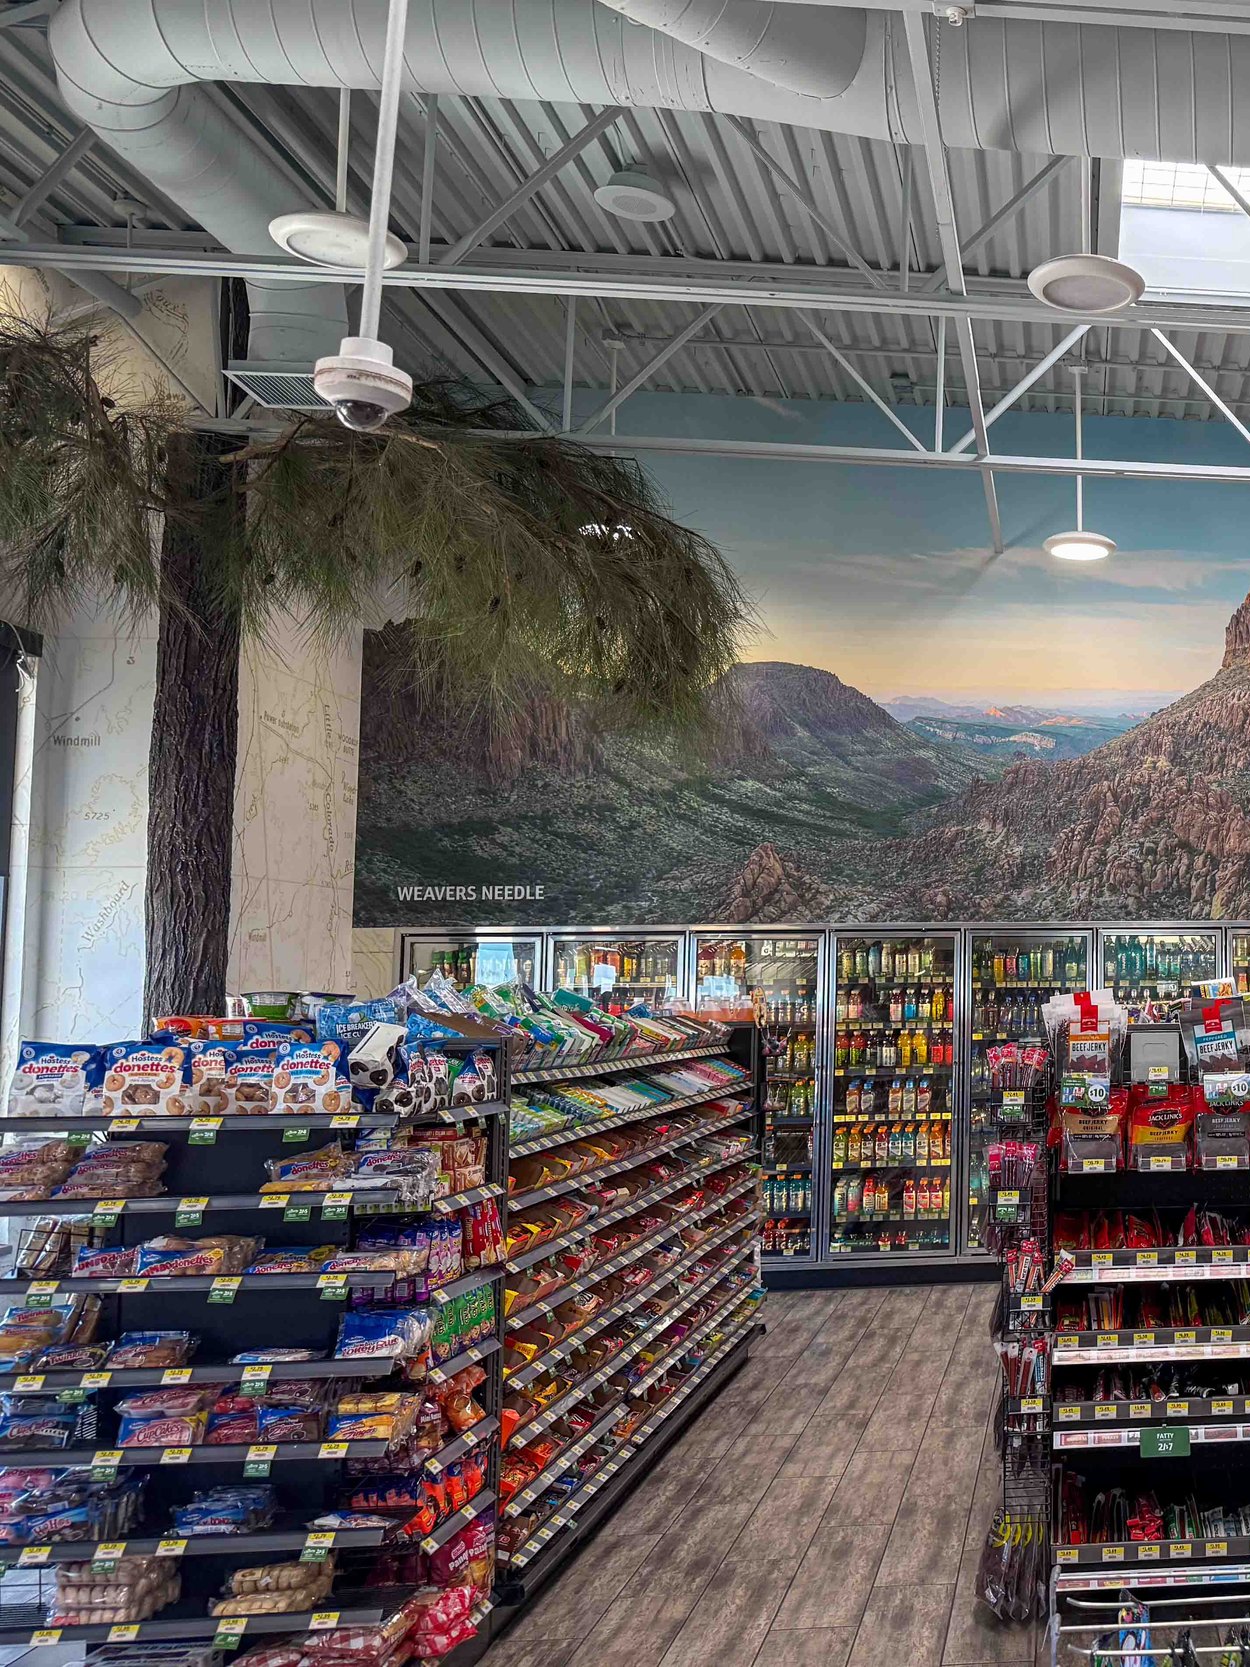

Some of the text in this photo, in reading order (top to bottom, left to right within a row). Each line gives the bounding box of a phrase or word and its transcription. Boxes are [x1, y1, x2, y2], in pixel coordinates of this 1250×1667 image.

[53, 736, 101, 747] Windmill
[84, 812, 110, 821] 5725
[325, 793, 335, 852] Colorado
[397, 885, 545, 901] WEAVERS NEEDLE
[1071, 1042, 1107, 1052] BEEF JERKY
[1200, 1041, 1233, 1054] BEEF JERKY
[40, 1057, 72, 1065] Hostess
[131, 1055, 163, 1063] Hostess
[295, 1052, 321, 1060] Hostess
[22, 1063, 79, 1074] donettes
[113, 1062, 177, 1074] donettes
[281, 1059, 332, 1071] donettes
[1089, 1088, 1105, 1097] $10
[1232, 1083, 1247, 1093] $10
[1148, 1114, 1164, 1122] JACK
[291, 1160, 329, 1175] donettes
[137, 1422, 181, 1443] CupCakes
